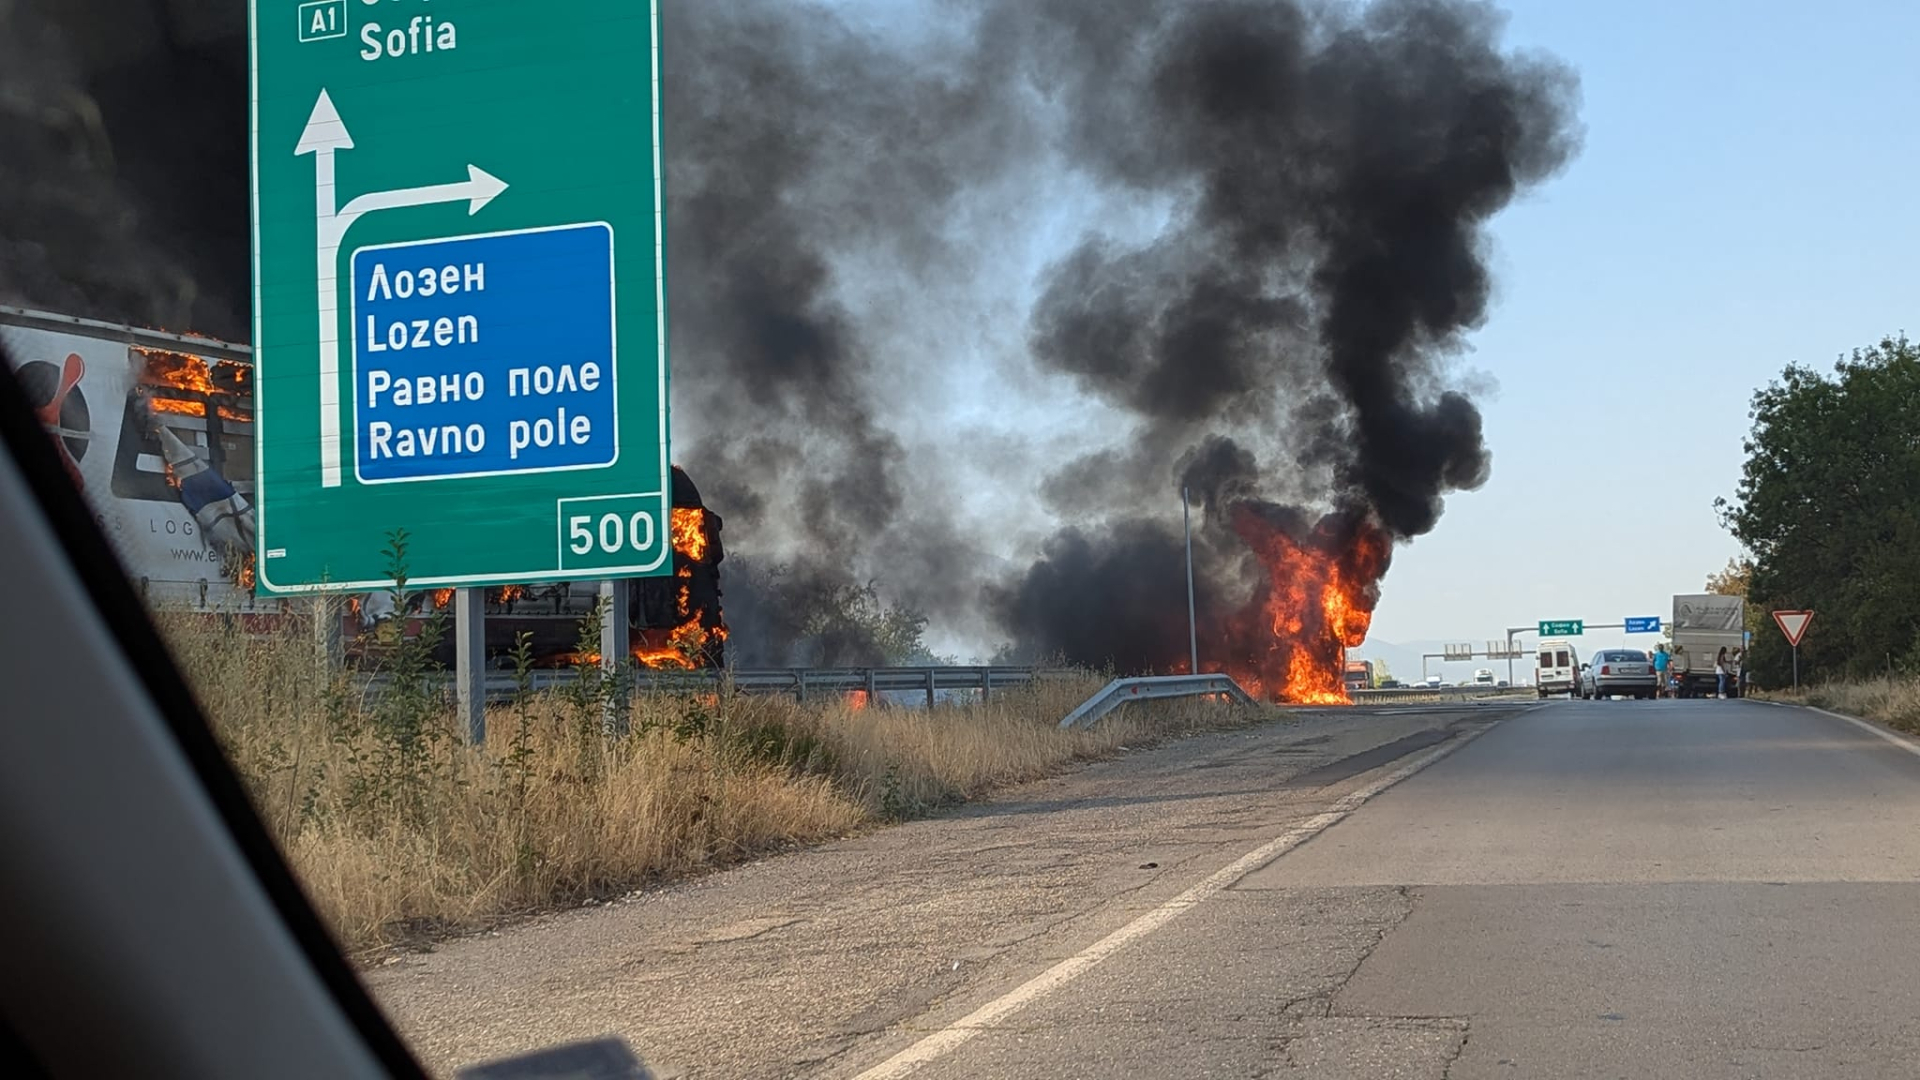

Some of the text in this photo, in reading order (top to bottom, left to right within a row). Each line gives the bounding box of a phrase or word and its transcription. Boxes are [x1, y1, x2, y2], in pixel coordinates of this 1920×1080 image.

[310, 7, 336, 34] A1
[360, 16, 457, 60] Sofia
[367, 262, 484, 301] Лозен
[367, 314, 478, 352] Lozen
[368, 361, 600, 408] Равно поле
[369, 407, 591, 459] Ravno pole
[150, 519, 194, 536] LOG
[570, 511, 654, 555] 500
[171, 549, 220, 562] www.e
